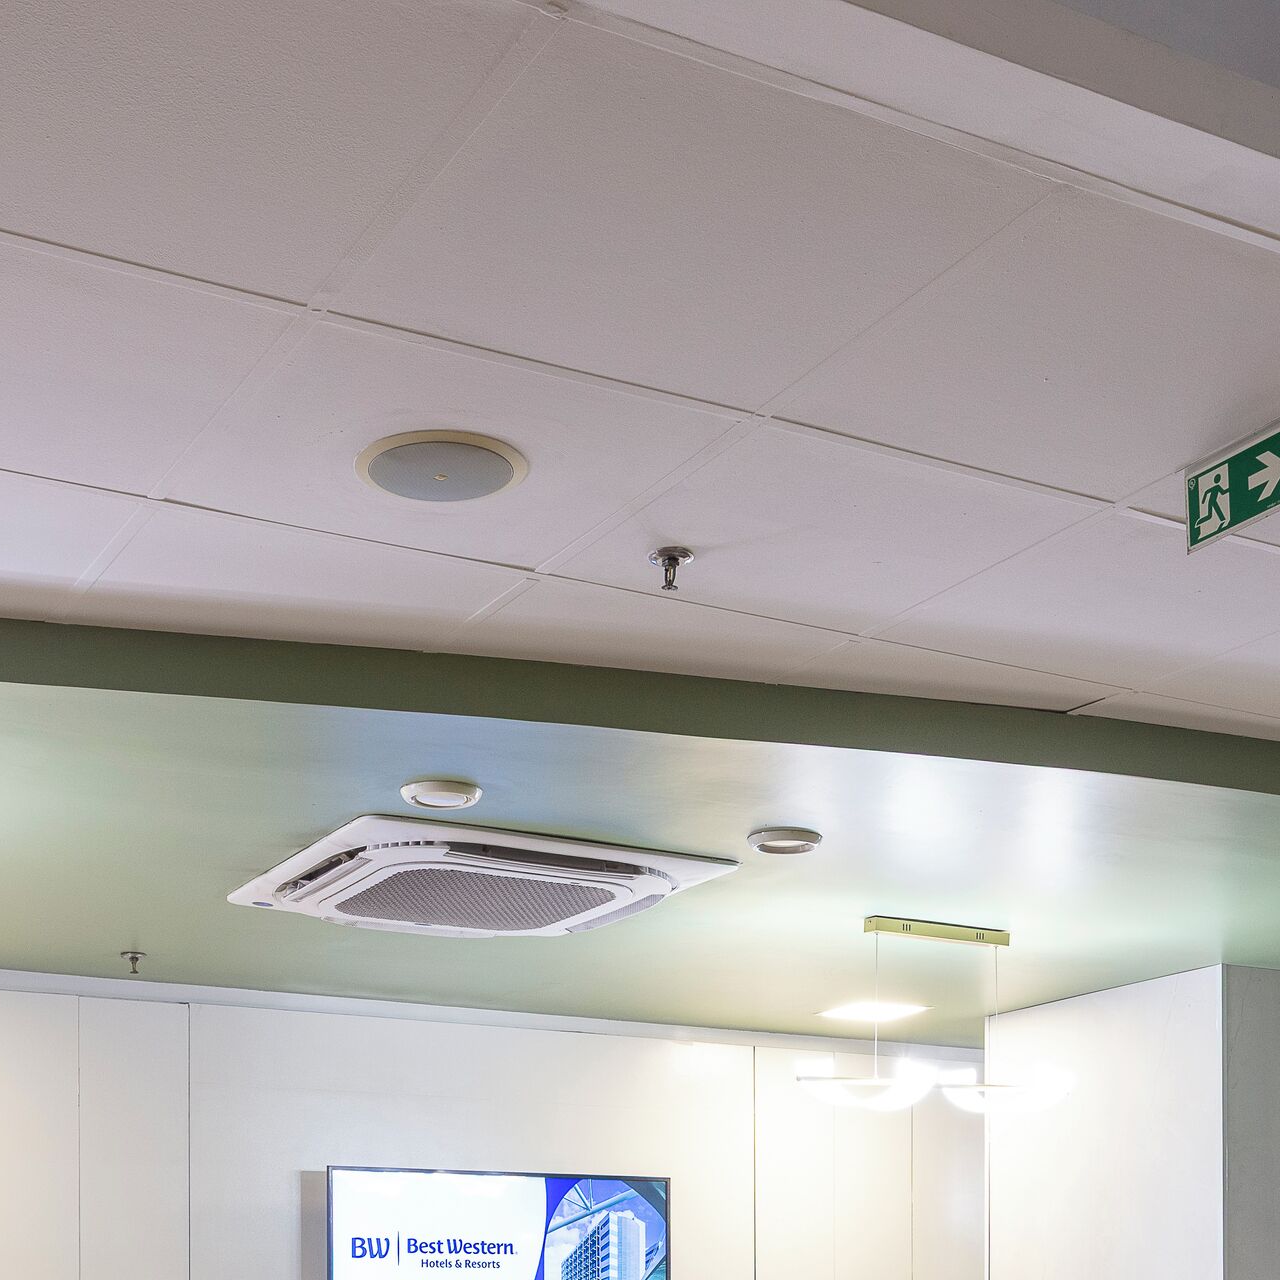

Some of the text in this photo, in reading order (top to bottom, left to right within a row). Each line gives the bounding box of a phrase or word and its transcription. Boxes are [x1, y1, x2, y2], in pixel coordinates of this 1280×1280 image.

[351, 1237, 390, 1259] BW
[407, 1238, 514, 1255] Best Western
[421, 1258, 501, 1269] Hotels & Resorts
